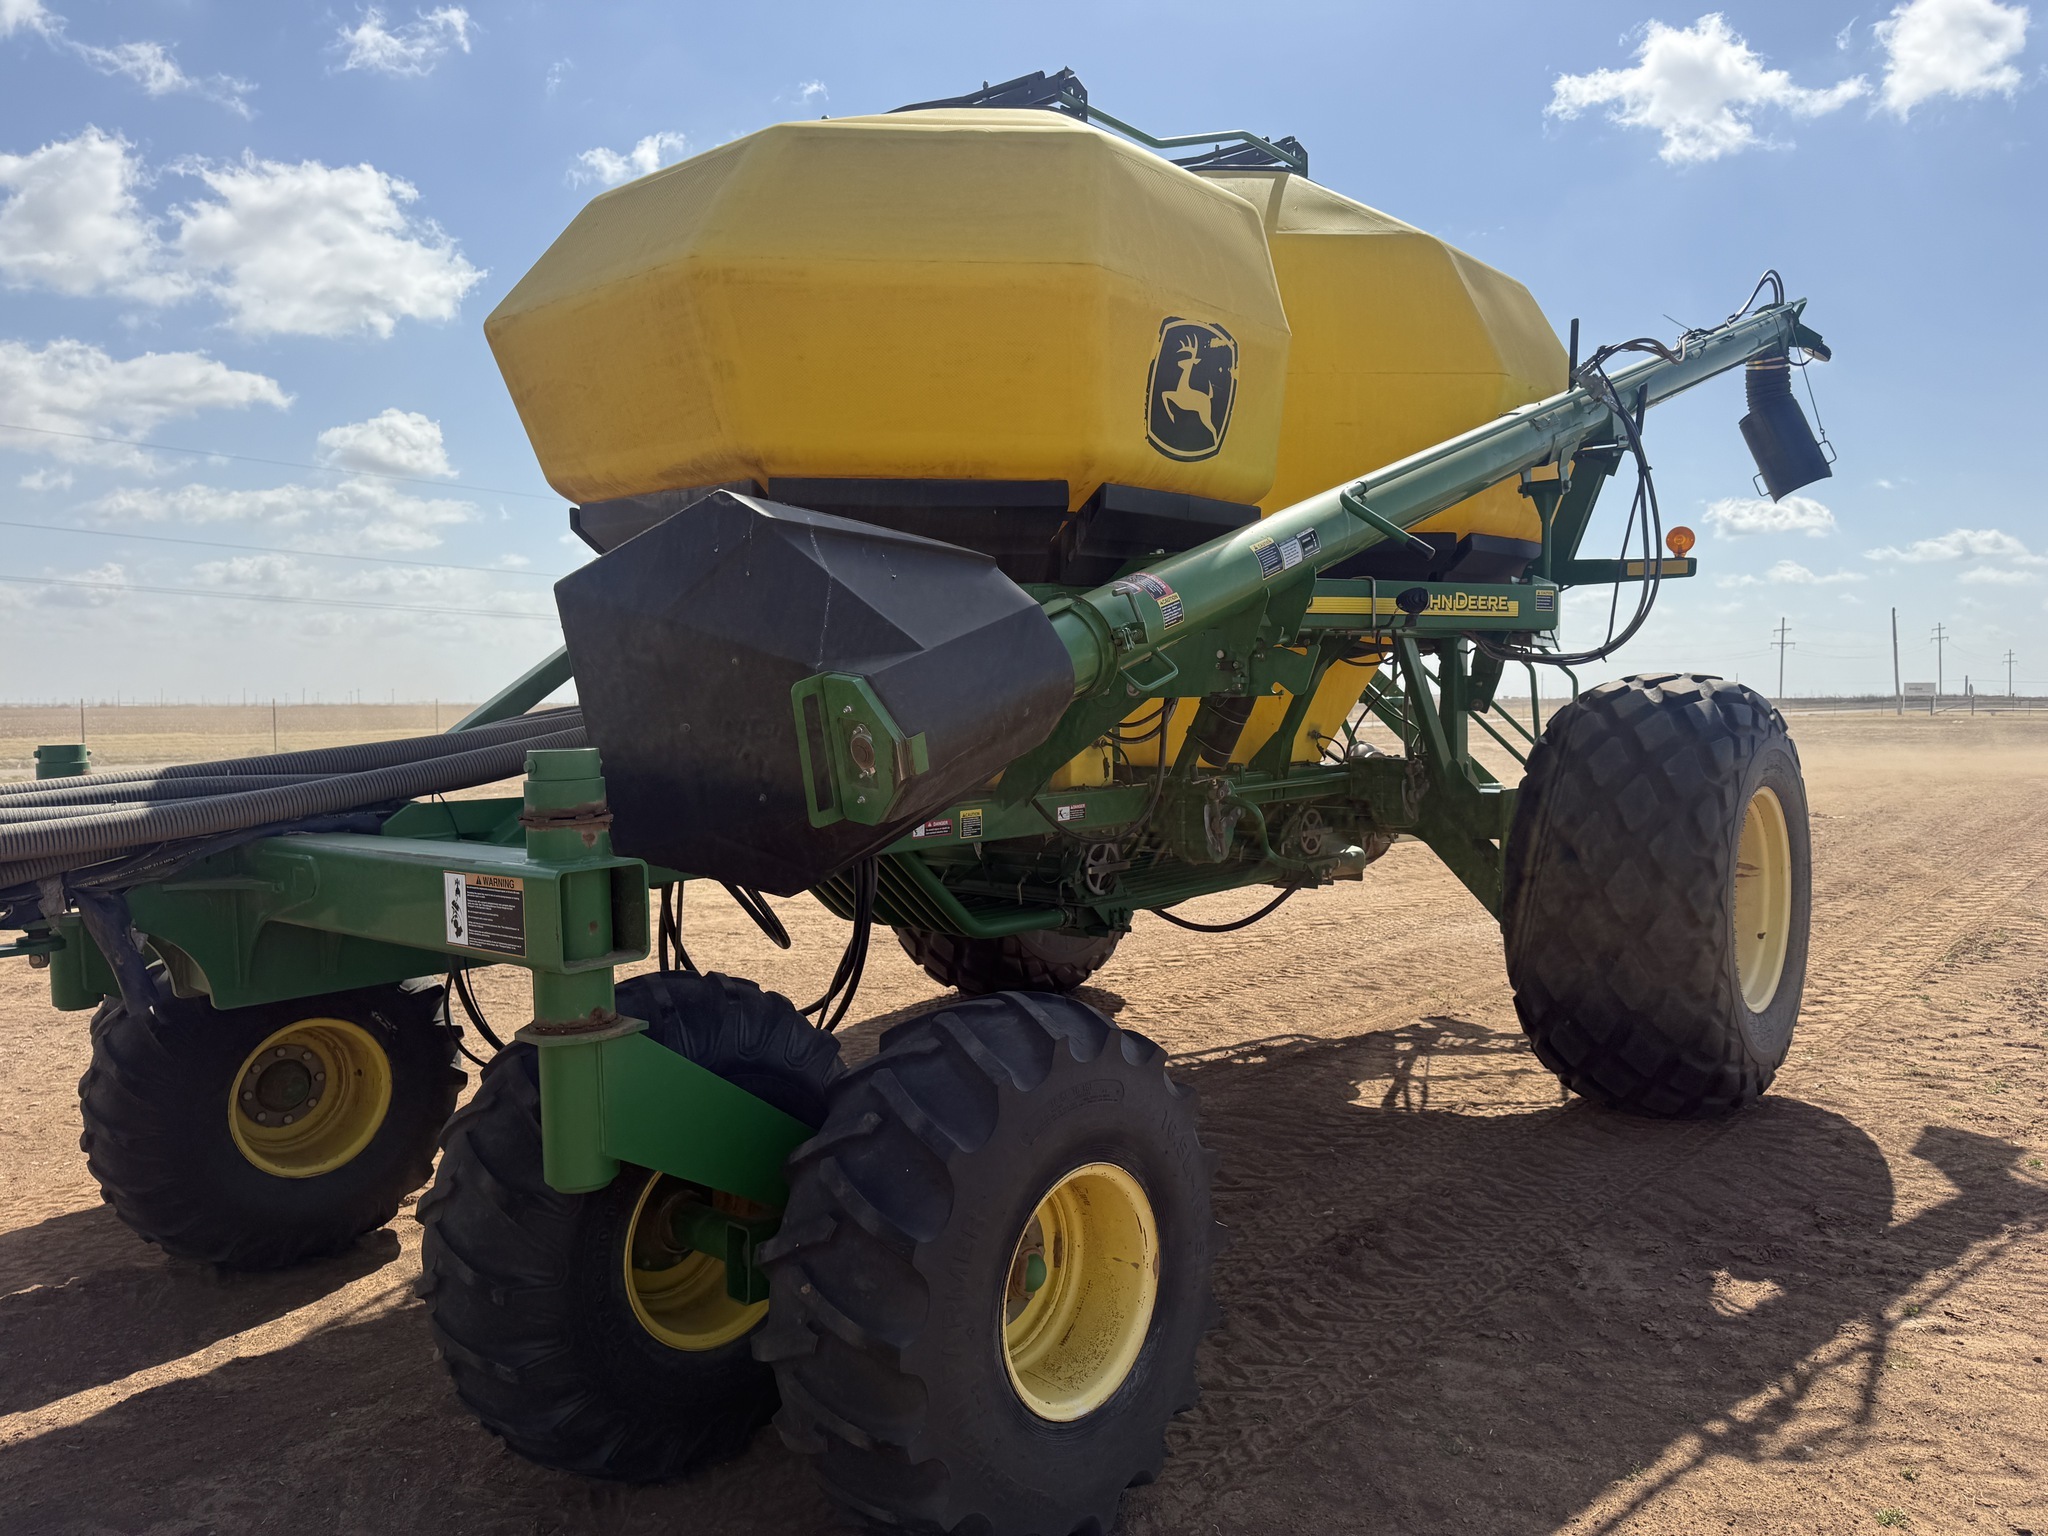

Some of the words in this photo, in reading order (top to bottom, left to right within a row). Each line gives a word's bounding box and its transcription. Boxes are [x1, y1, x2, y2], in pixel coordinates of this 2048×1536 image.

[1429, 594, 1453, 609] HN
[1455, 592, 1508, 610] DEERE
[482, 876, 515, 889] WARNING
